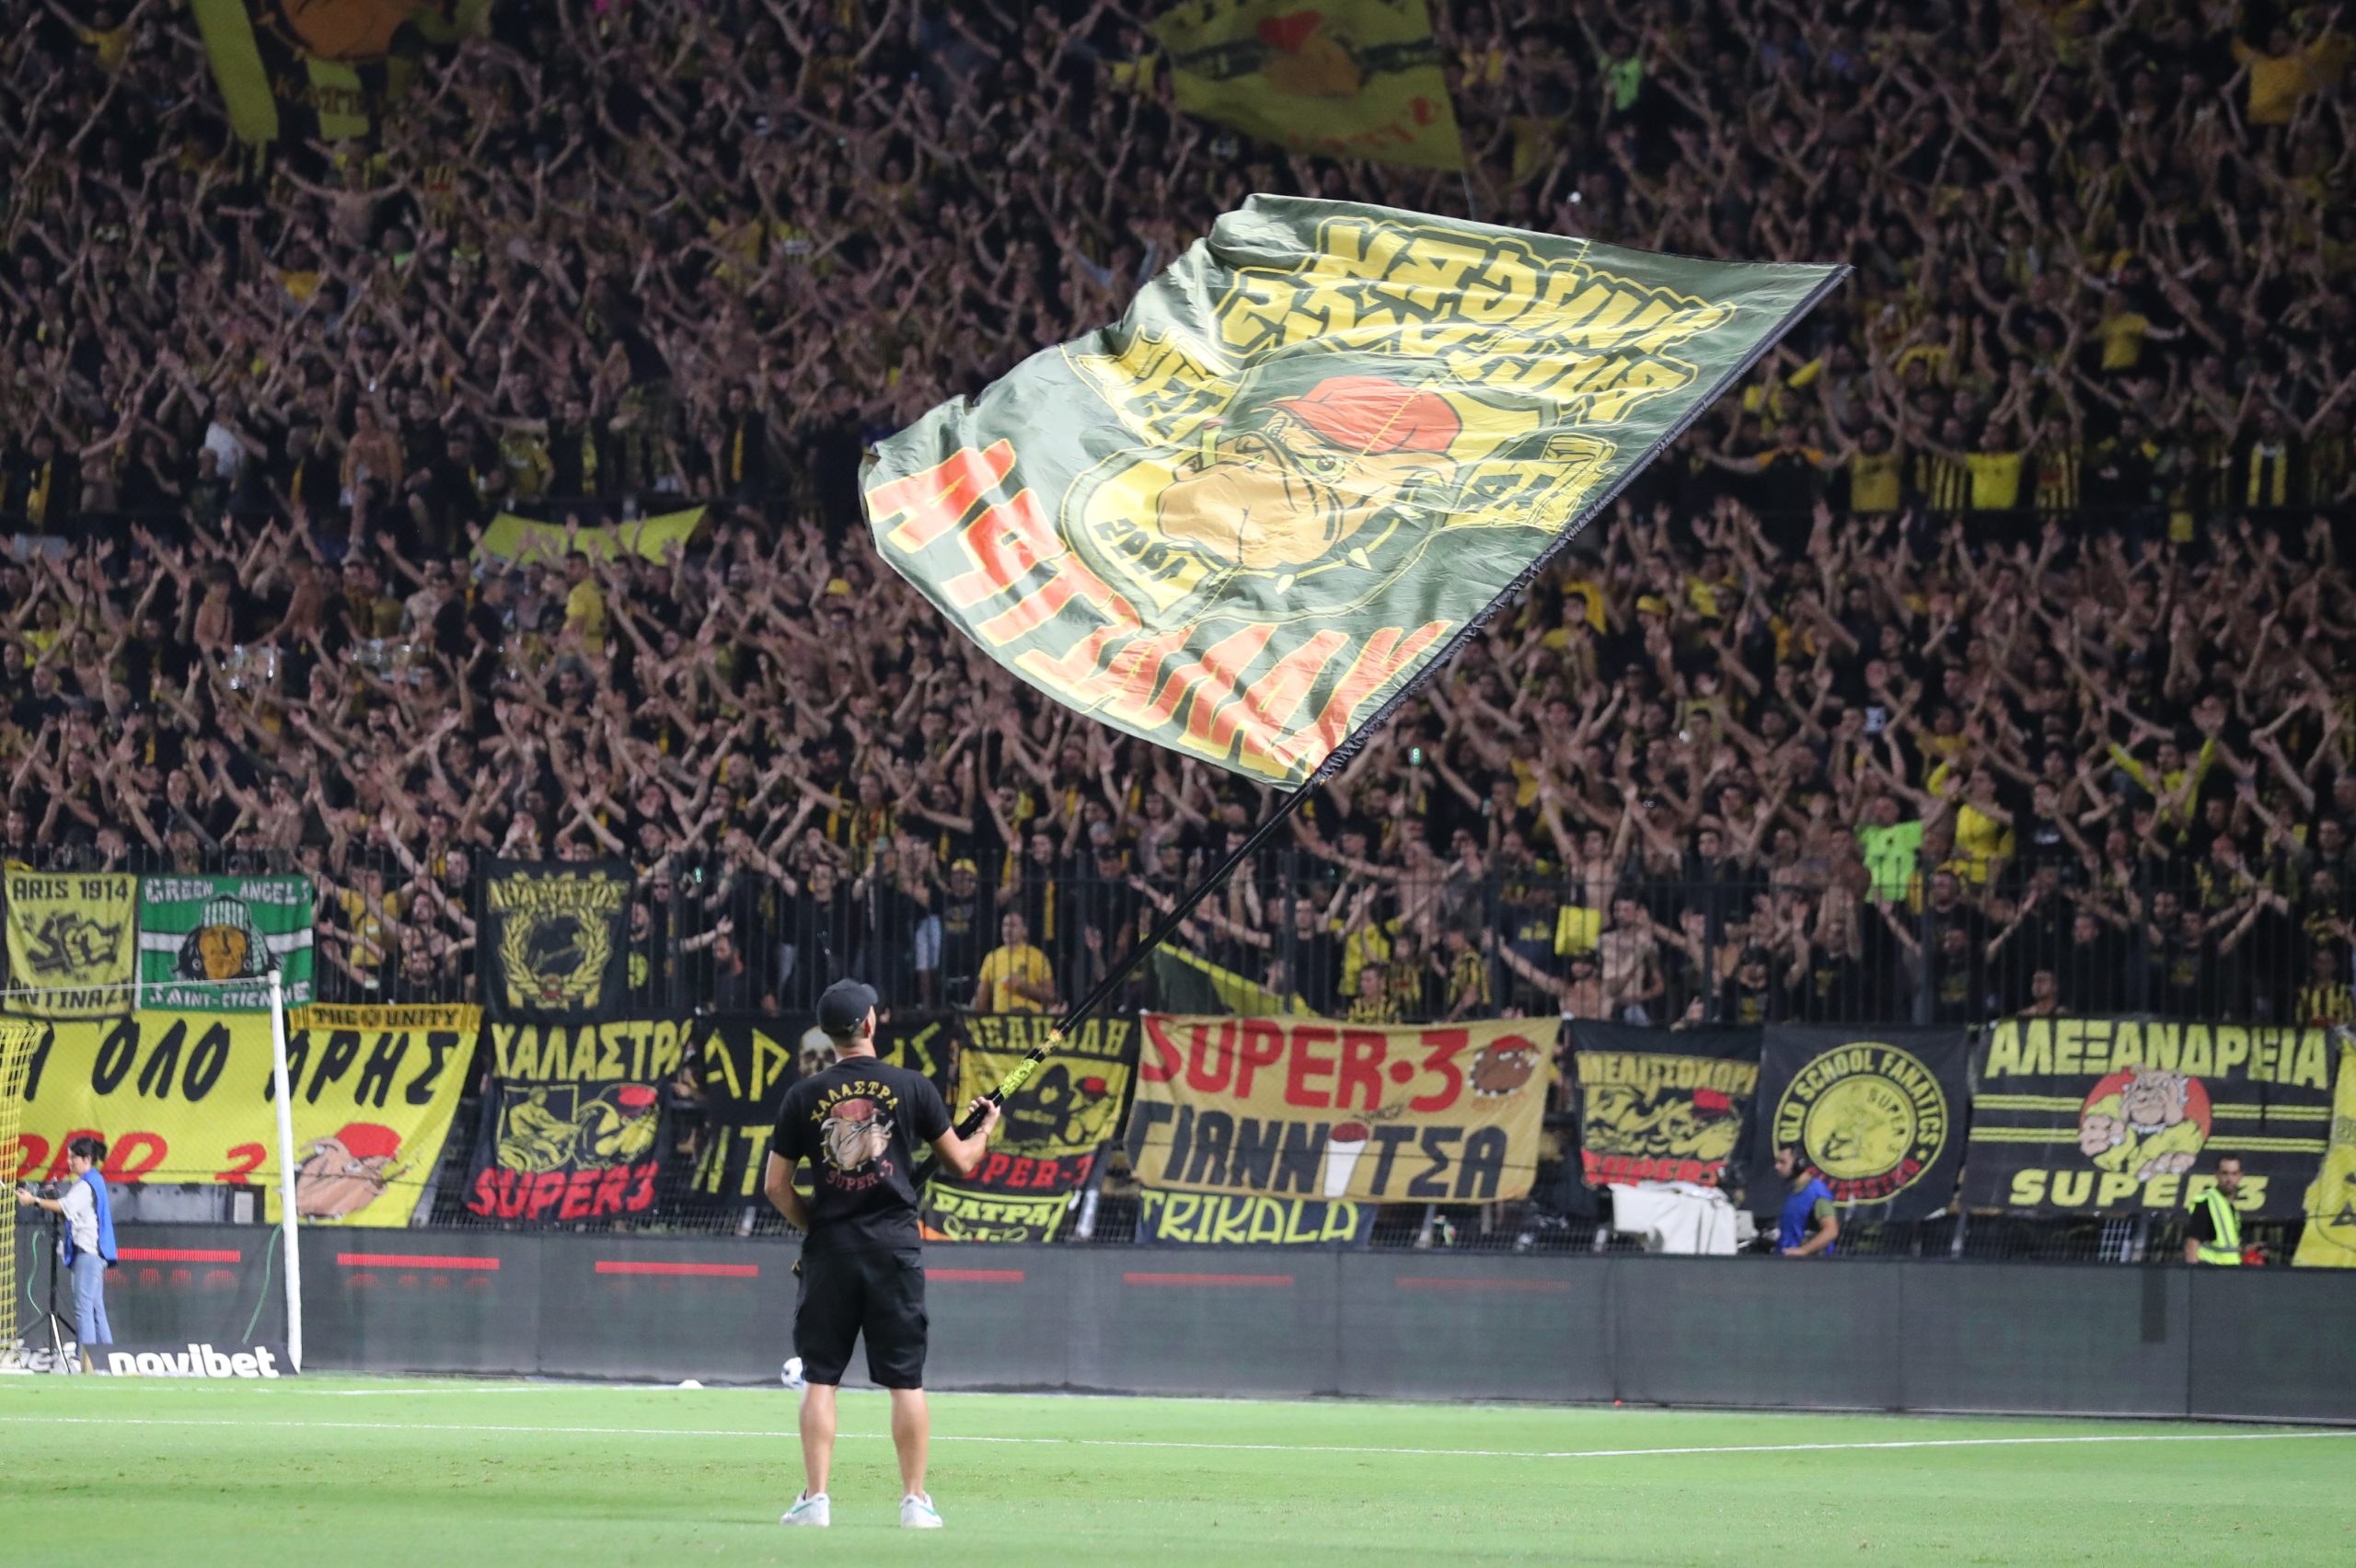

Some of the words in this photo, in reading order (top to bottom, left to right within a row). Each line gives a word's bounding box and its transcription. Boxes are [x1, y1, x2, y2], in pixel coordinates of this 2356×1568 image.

[13, 877, 68, 901] ARIS
[79, 877, 129, 901] 1914
[144, 878, 214, 904] GREEN
[239, 880, 310, 905] ANGELS
[9, 976, 131, 1009] ANTINAZI
[312, 1008, 357, 1025] THE
[386, 1009, 458, 1027] UNITY
[1779, 1101, 1807, 1143] OLD
[1795, 1049, 1875, 1101] SCHOOL
[1879, 1050, 1943, 1146] FANATICS
[108, 1343, 280, 1378] novibet
